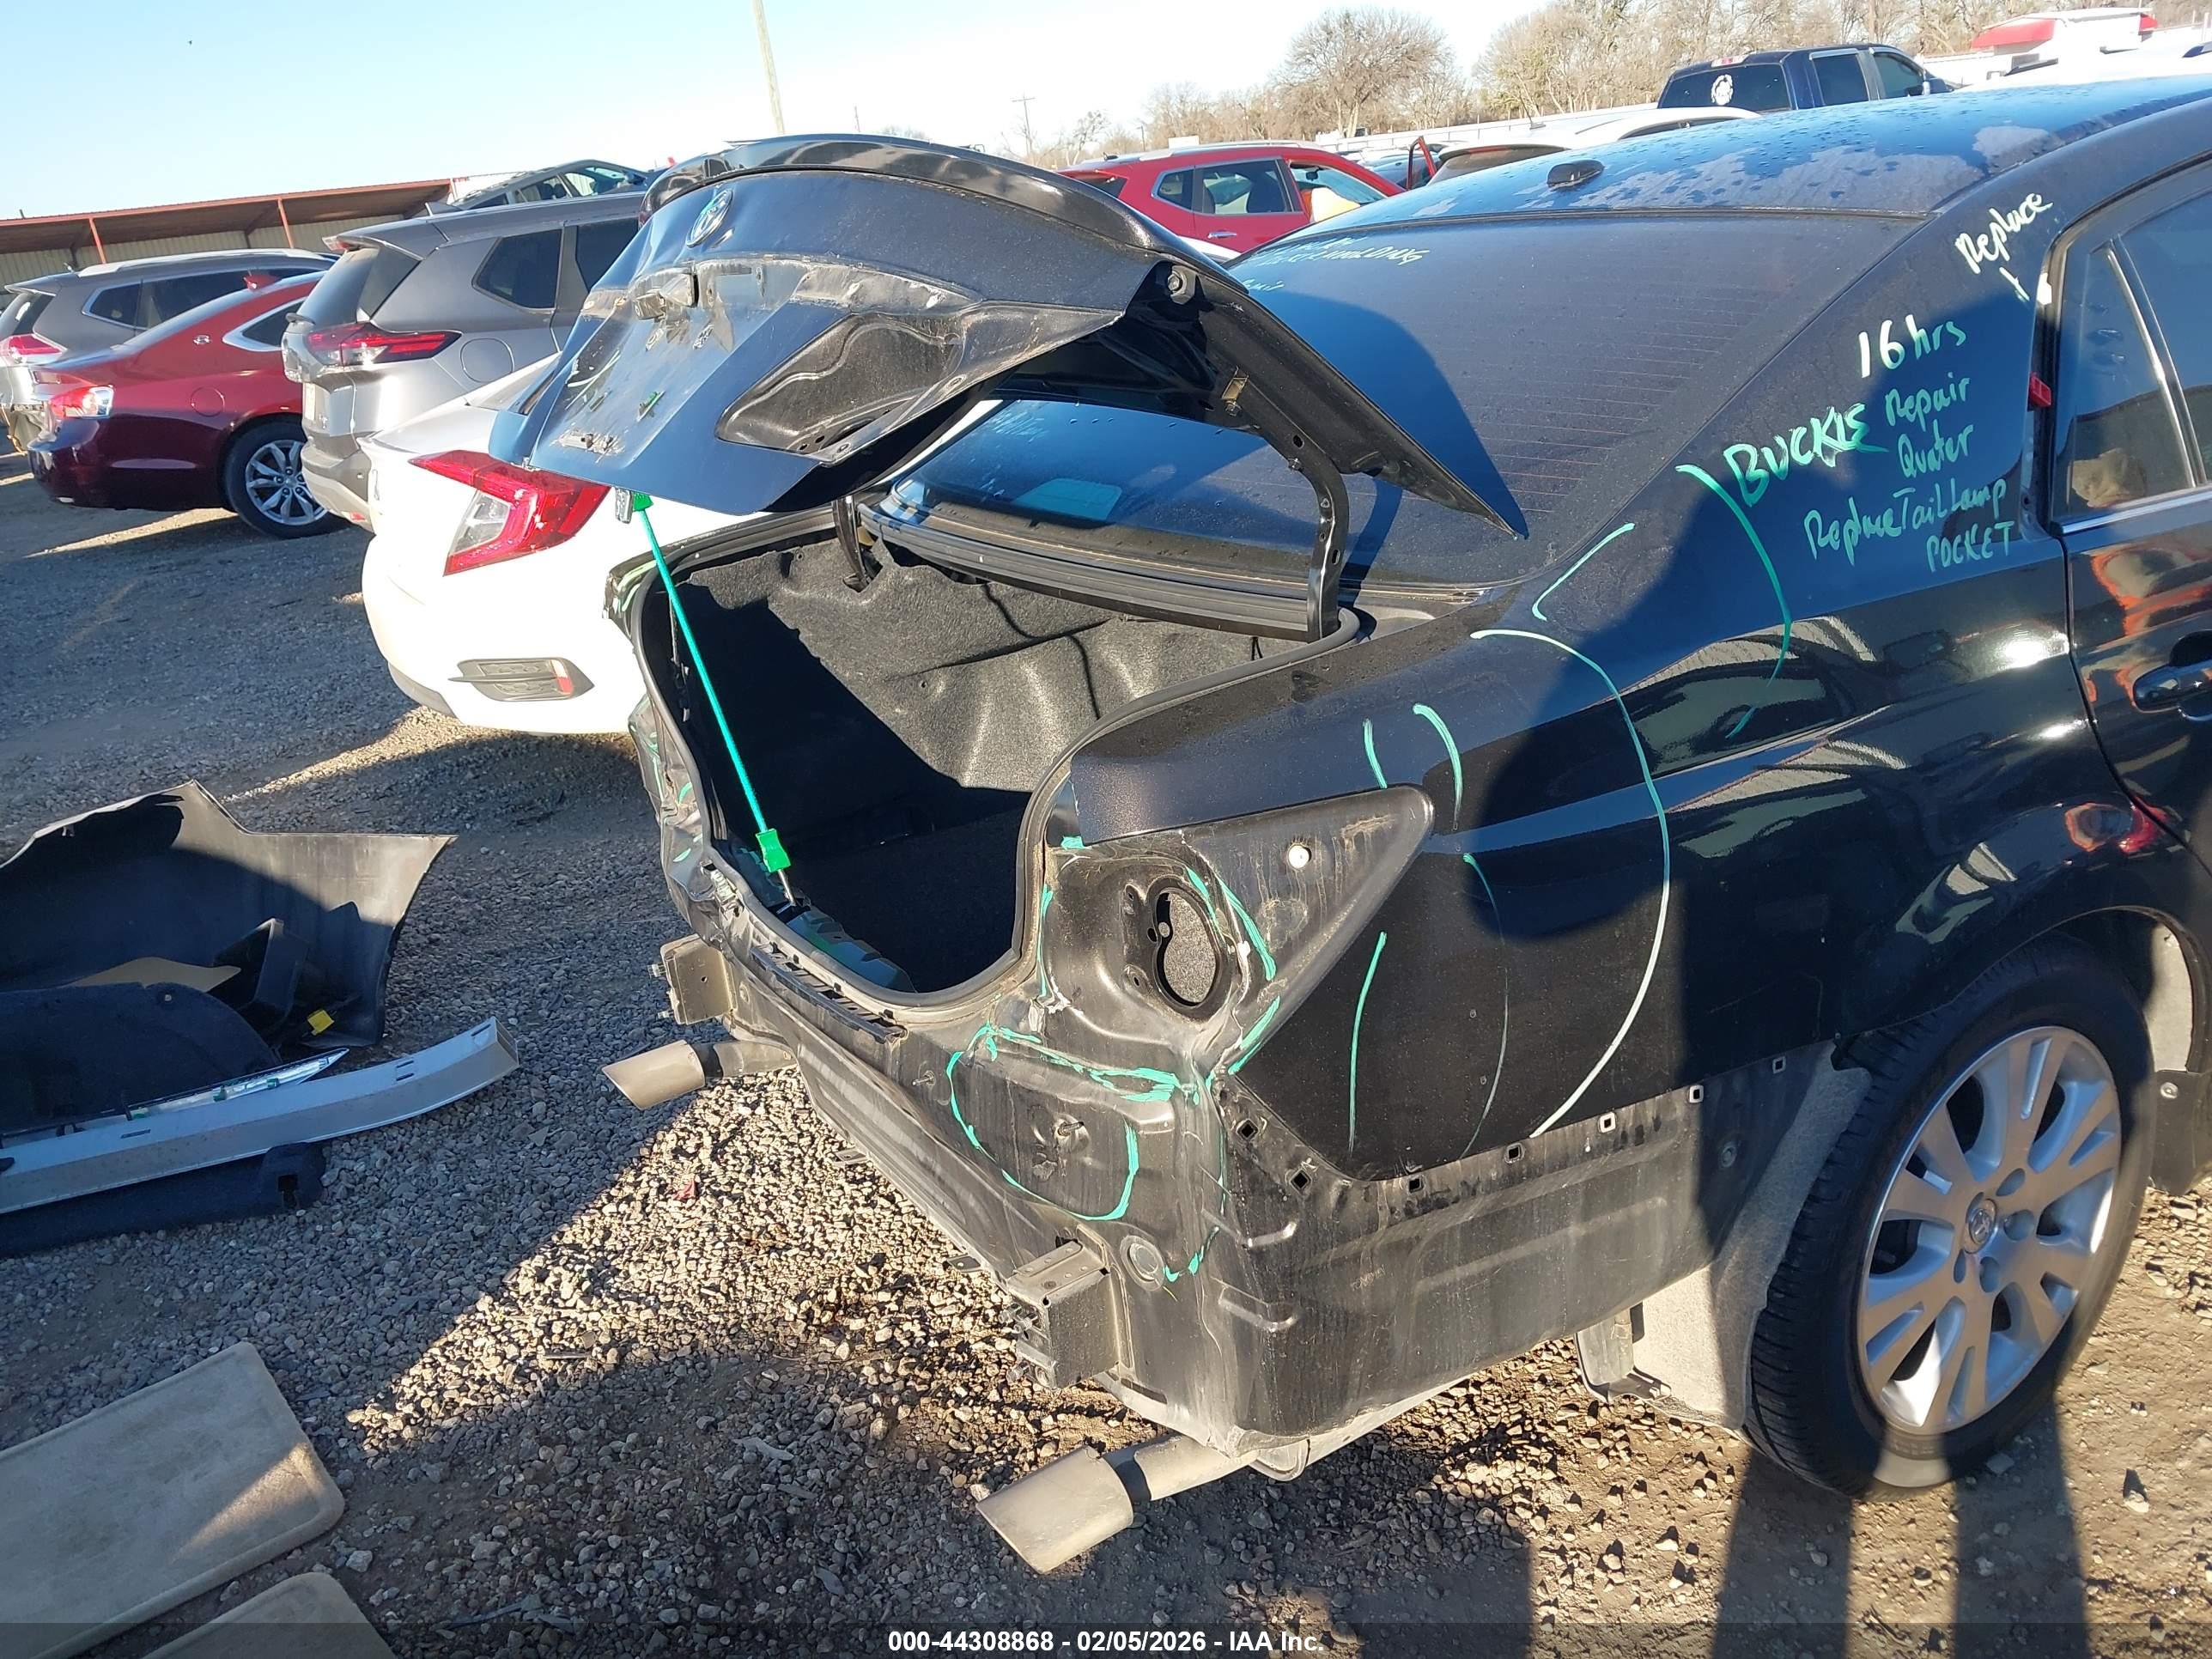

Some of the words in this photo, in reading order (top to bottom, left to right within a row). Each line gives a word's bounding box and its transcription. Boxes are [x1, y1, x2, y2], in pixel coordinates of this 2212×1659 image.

[1955, 192, 2053, 274] Replace
[1885, 371, 1970, 432] Repair
[1926, 521, 2014, 572] POCKET
